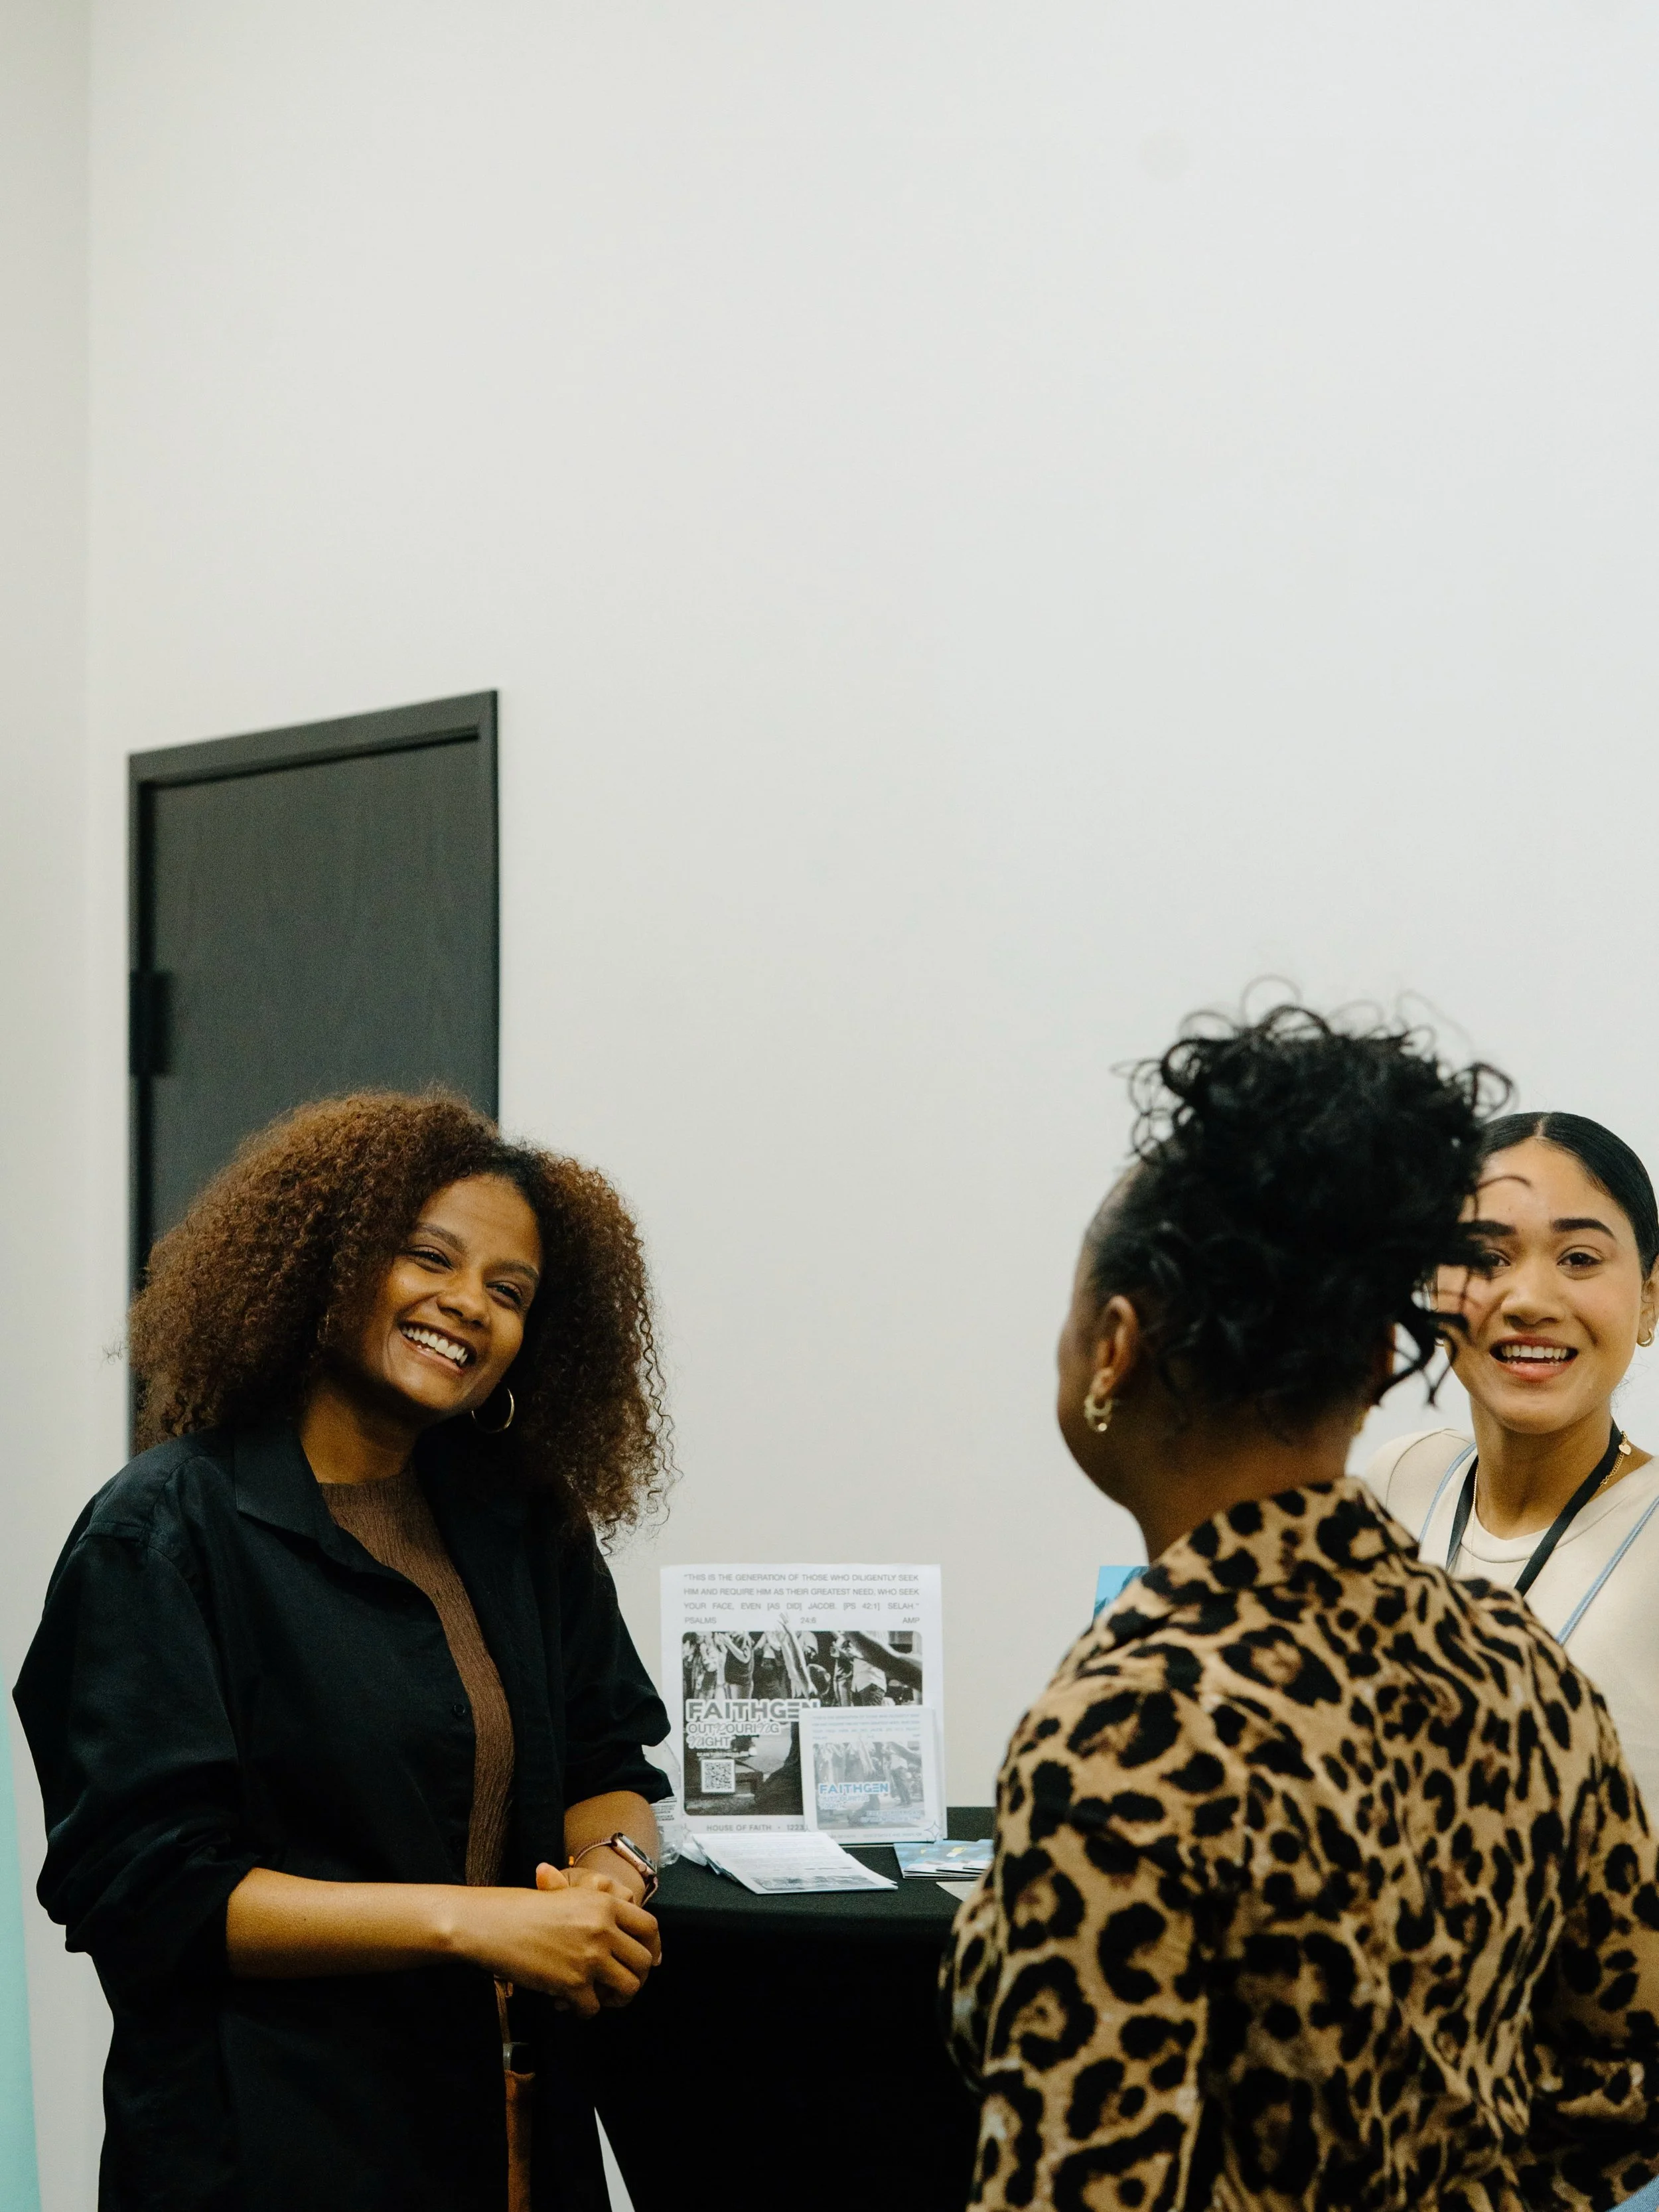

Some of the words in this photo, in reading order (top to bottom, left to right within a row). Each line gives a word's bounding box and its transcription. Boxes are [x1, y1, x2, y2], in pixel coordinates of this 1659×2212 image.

[767, 1602, 780, 1611] [AS
[786, 1602, 802, 1611] DID]
[843, 1602, 856, 1611] [PS
[687, 1723, 780, 1733] OUTPOURING
[689, 1735, 730, 1747] NIGHT
[820, 1783, 889, 1794] FAITHGEN
